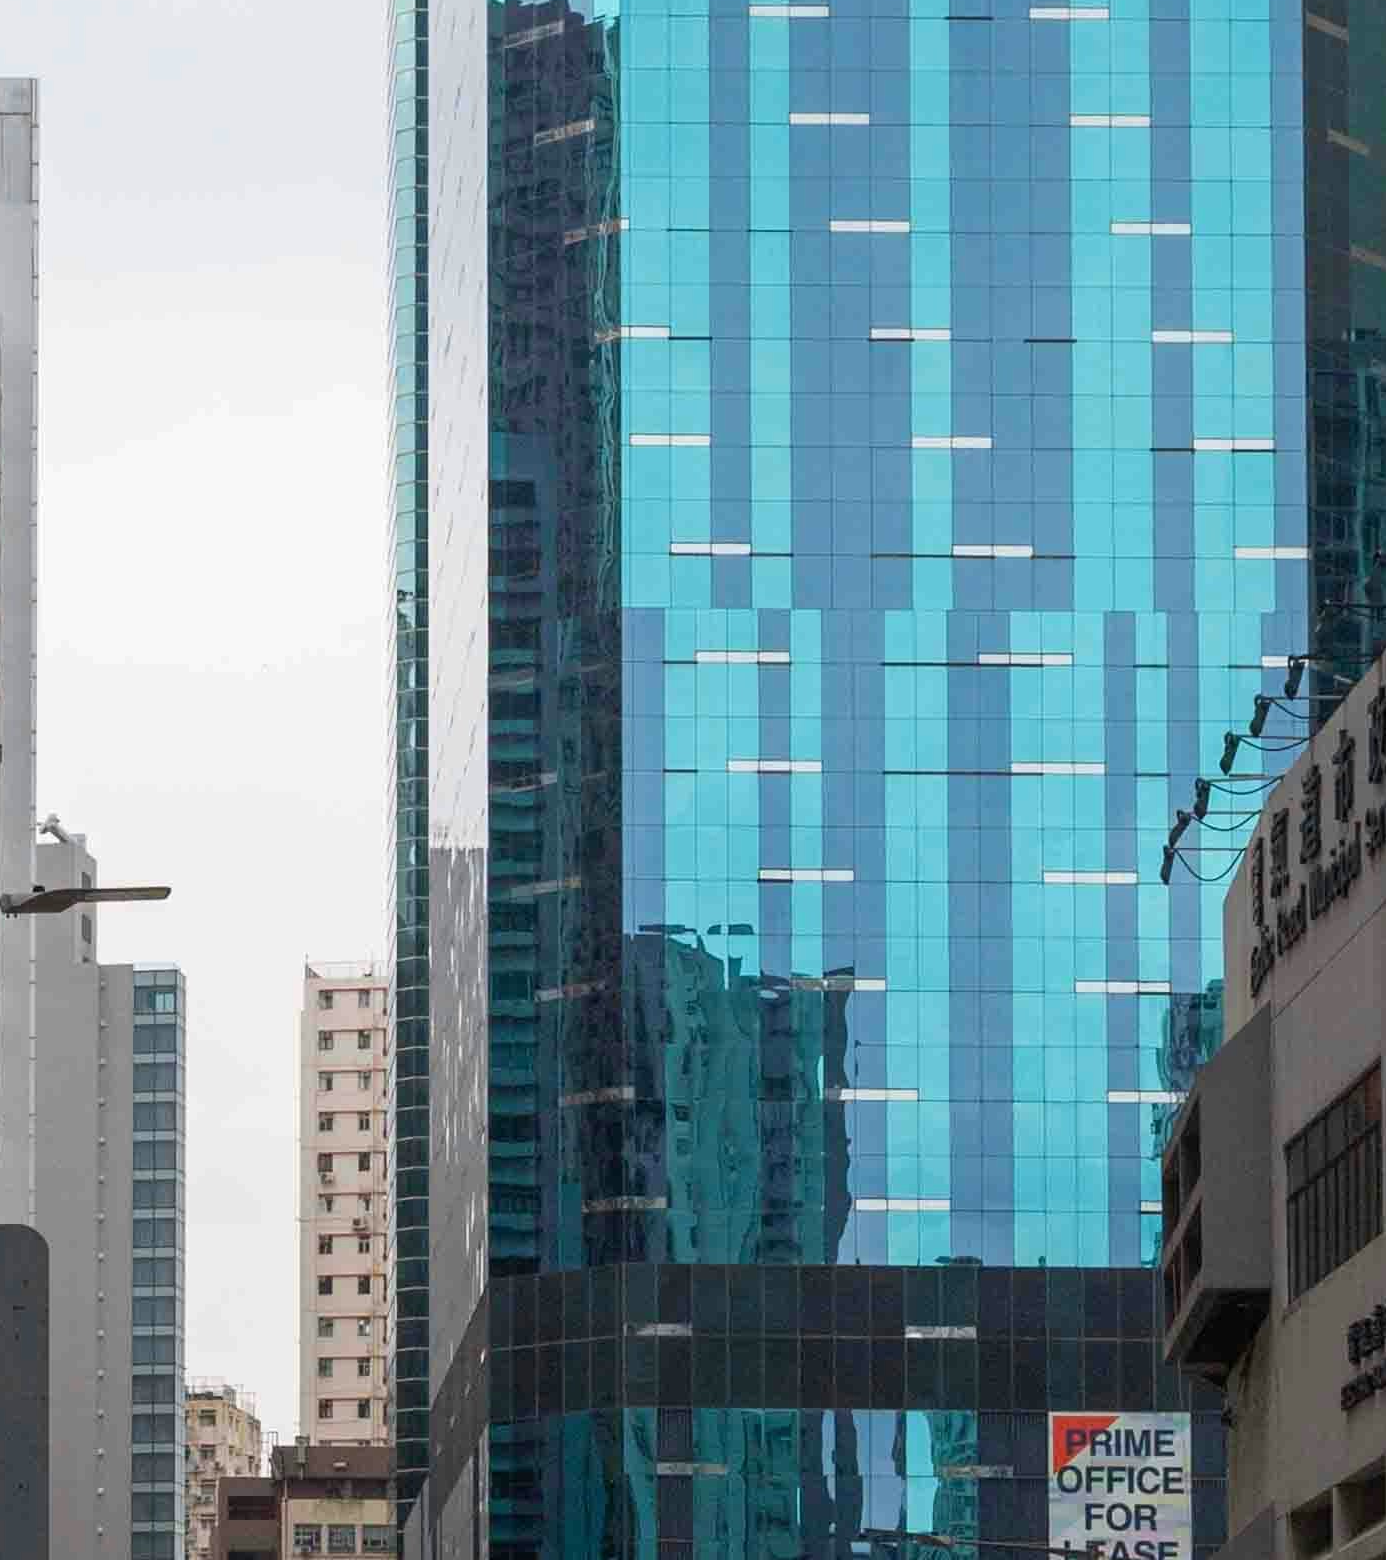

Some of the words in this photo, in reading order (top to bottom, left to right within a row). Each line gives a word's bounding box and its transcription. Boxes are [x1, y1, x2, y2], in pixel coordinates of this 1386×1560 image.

[1066, 1429, 1175, 1457] PRIME
[1057, 1466, 1185, 1495] OFFICE
[1085, 1504, 1157, 1531] FOR
